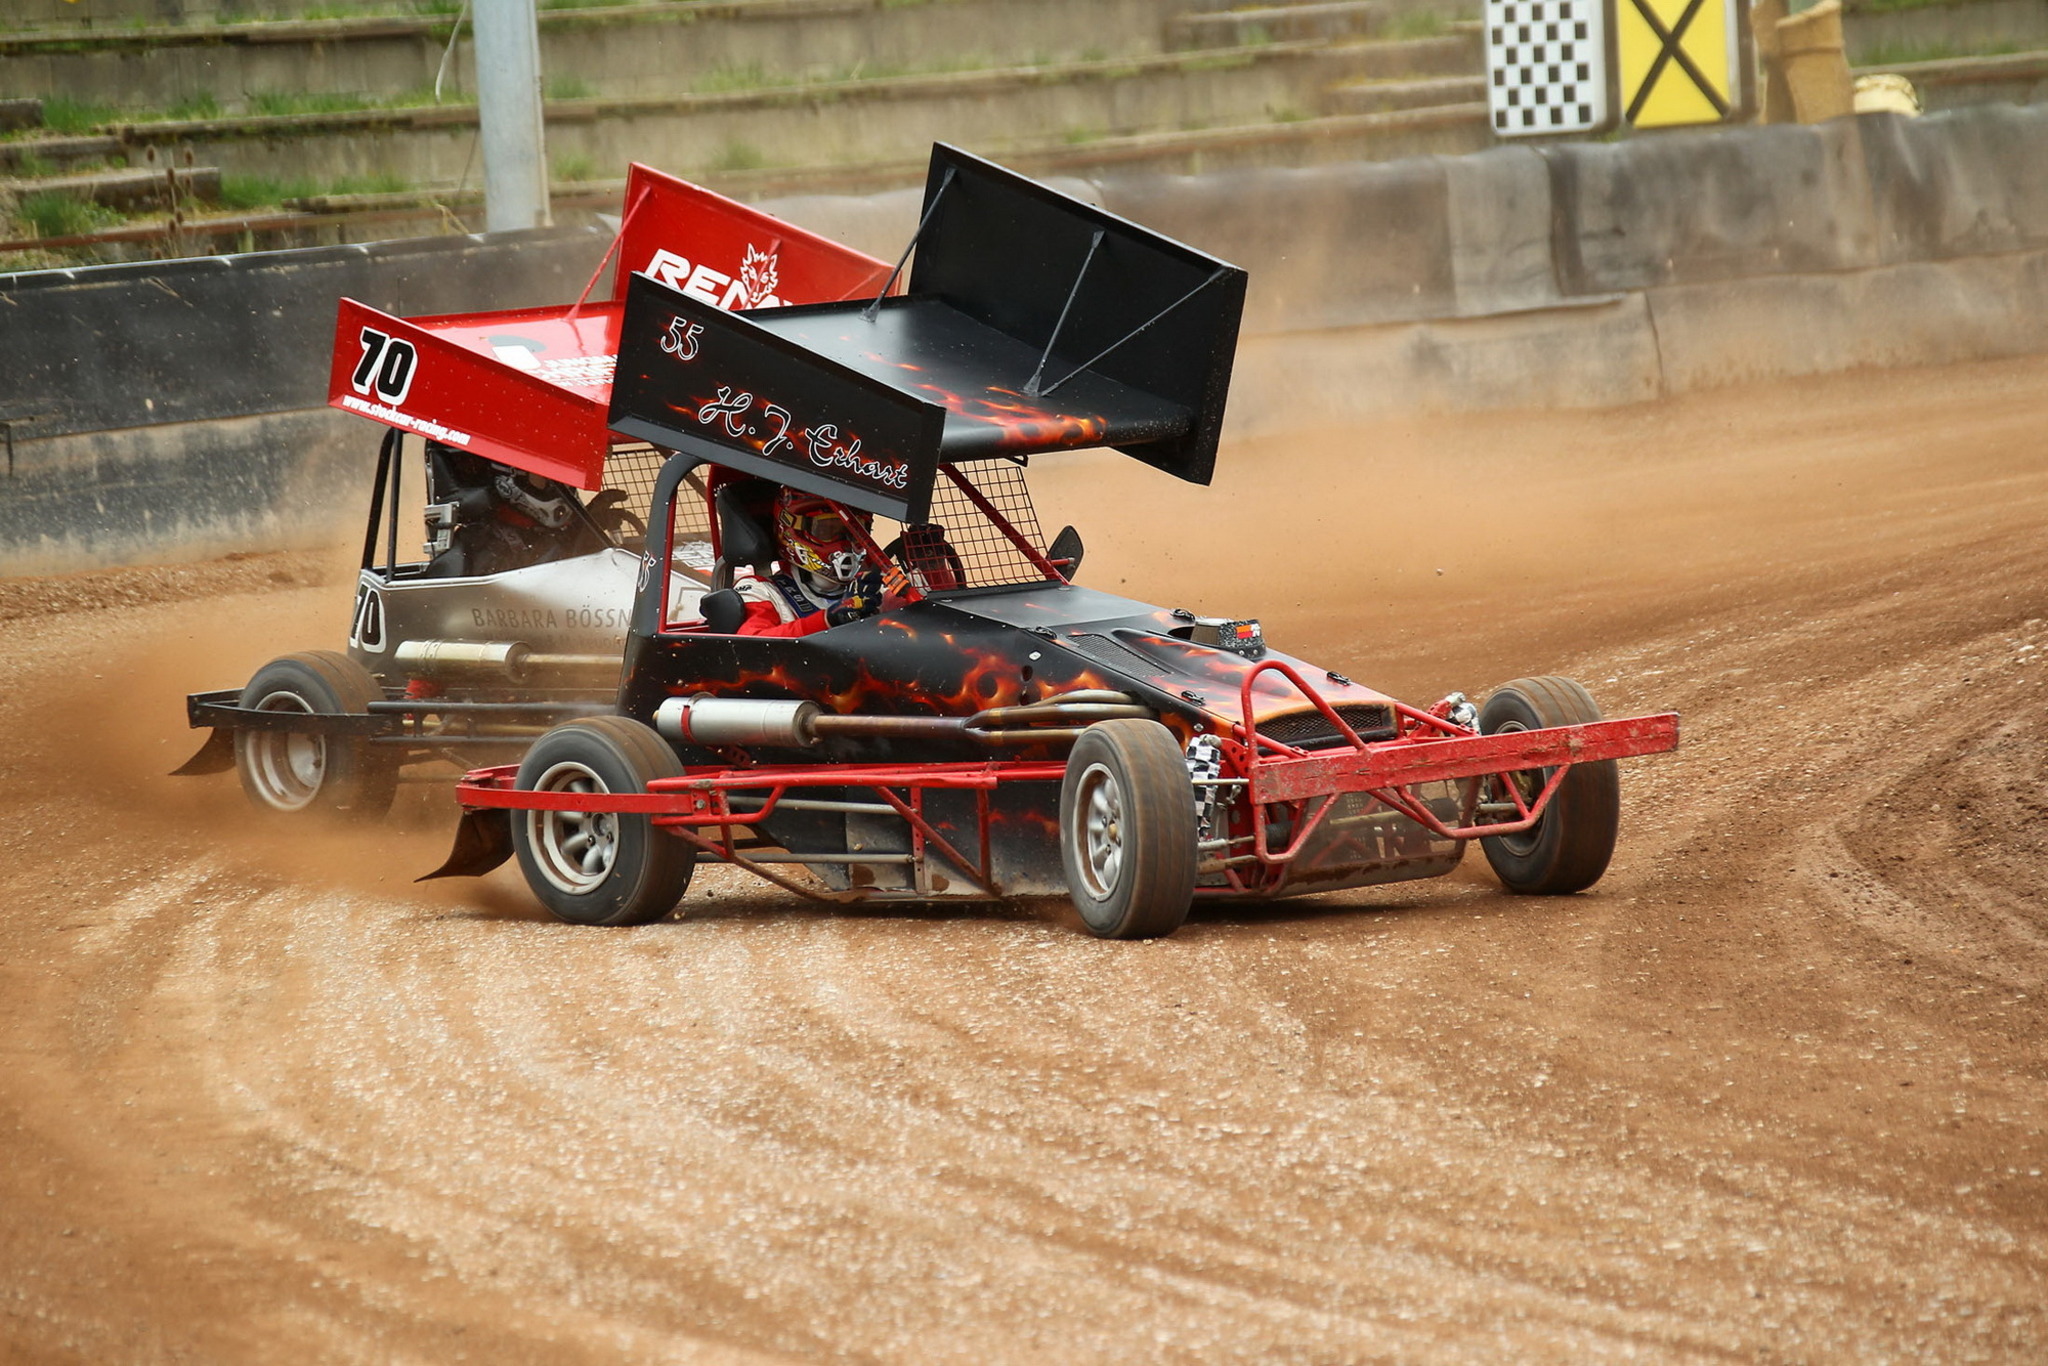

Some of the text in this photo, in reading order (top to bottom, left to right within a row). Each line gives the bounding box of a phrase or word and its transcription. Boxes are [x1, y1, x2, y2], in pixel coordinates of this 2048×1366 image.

[660, 315, 704, 361] 55
[351, 325, 418, 406] 70
[342, 394, 471, 446] www.stockcar-racing.com
[699, 386, 756, 437] H.
[350, 580, 387, 653] 70
[471, 608, 558, 629] BARBARA
